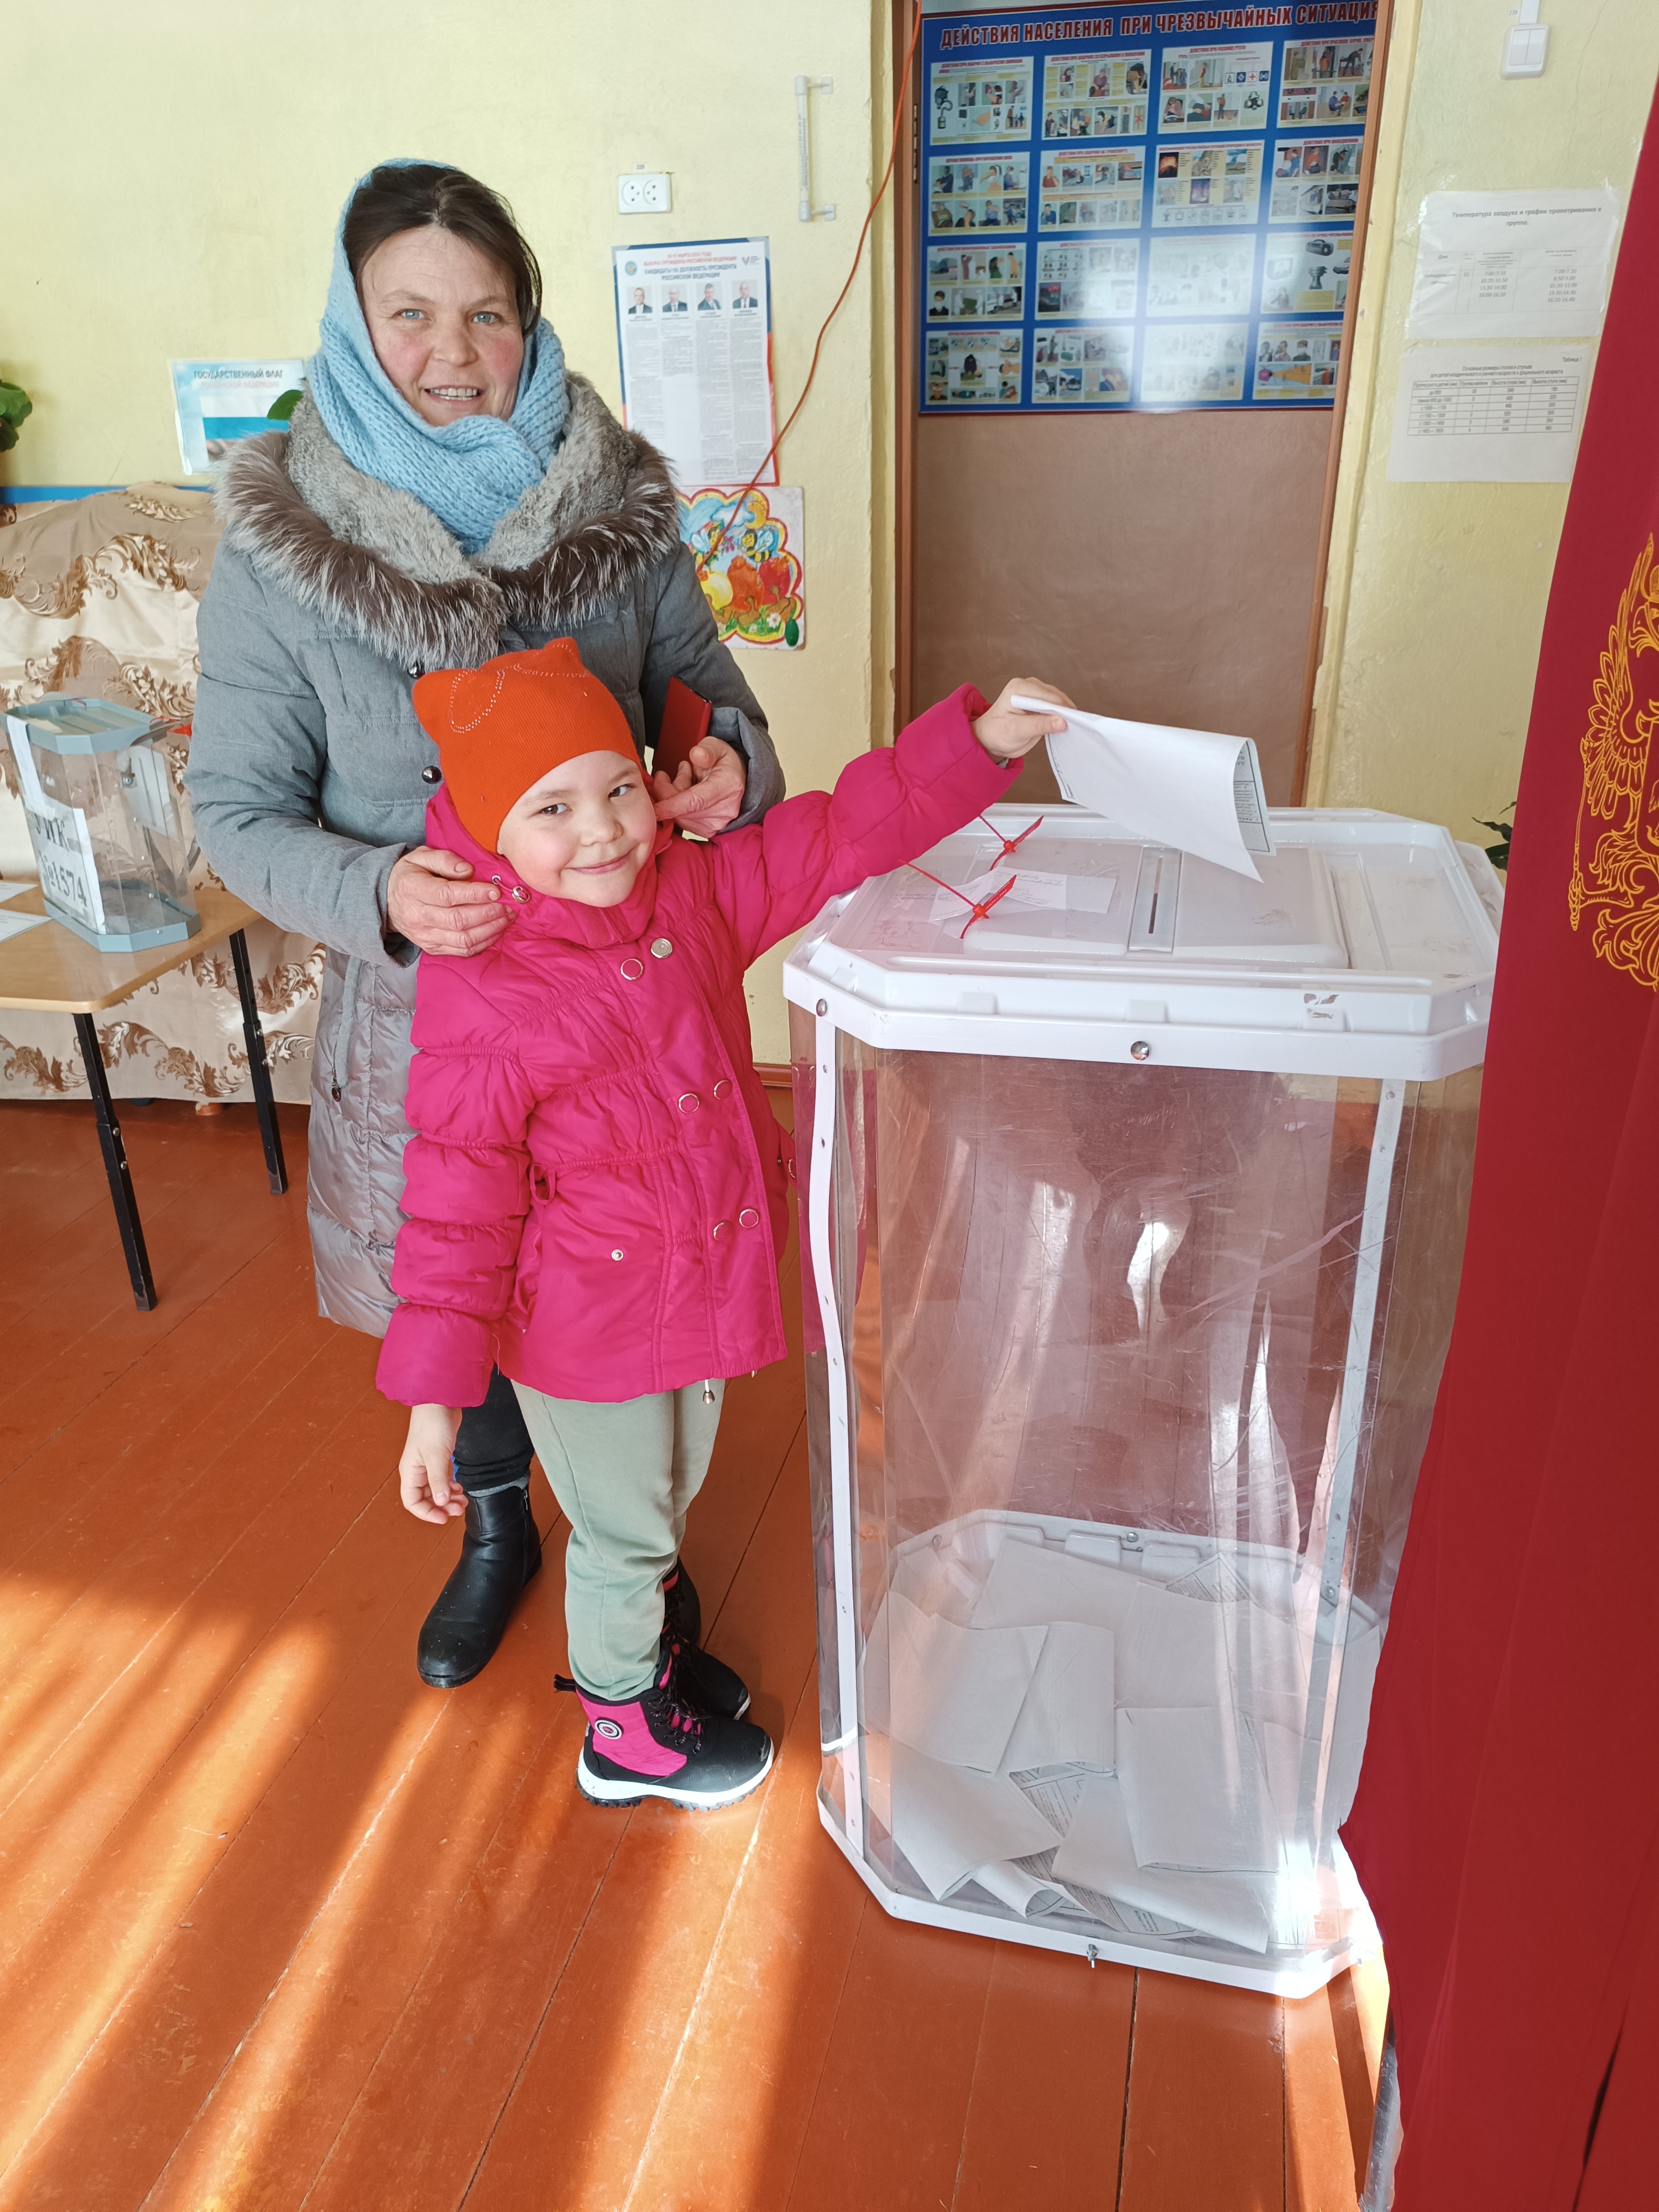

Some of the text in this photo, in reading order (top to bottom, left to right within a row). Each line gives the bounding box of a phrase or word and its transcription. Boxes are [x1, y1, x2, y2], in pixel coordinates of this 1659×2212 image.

[940, 24, 1020, 50] ДЕЙСТВИЯ
[1023, 18, 1113, 42] НАСЕЛЕНИЯ
[1120, 15, 1152, 35] ПРИ
[1156, 5, 1292, 33] ЧРЕЗВЫЧАЙНЫХ
[194, 368, 283, 379] ГОСУДАРСТВЕННЫЙ ФЛАГ
[39, 849, 87, 907] №1574
